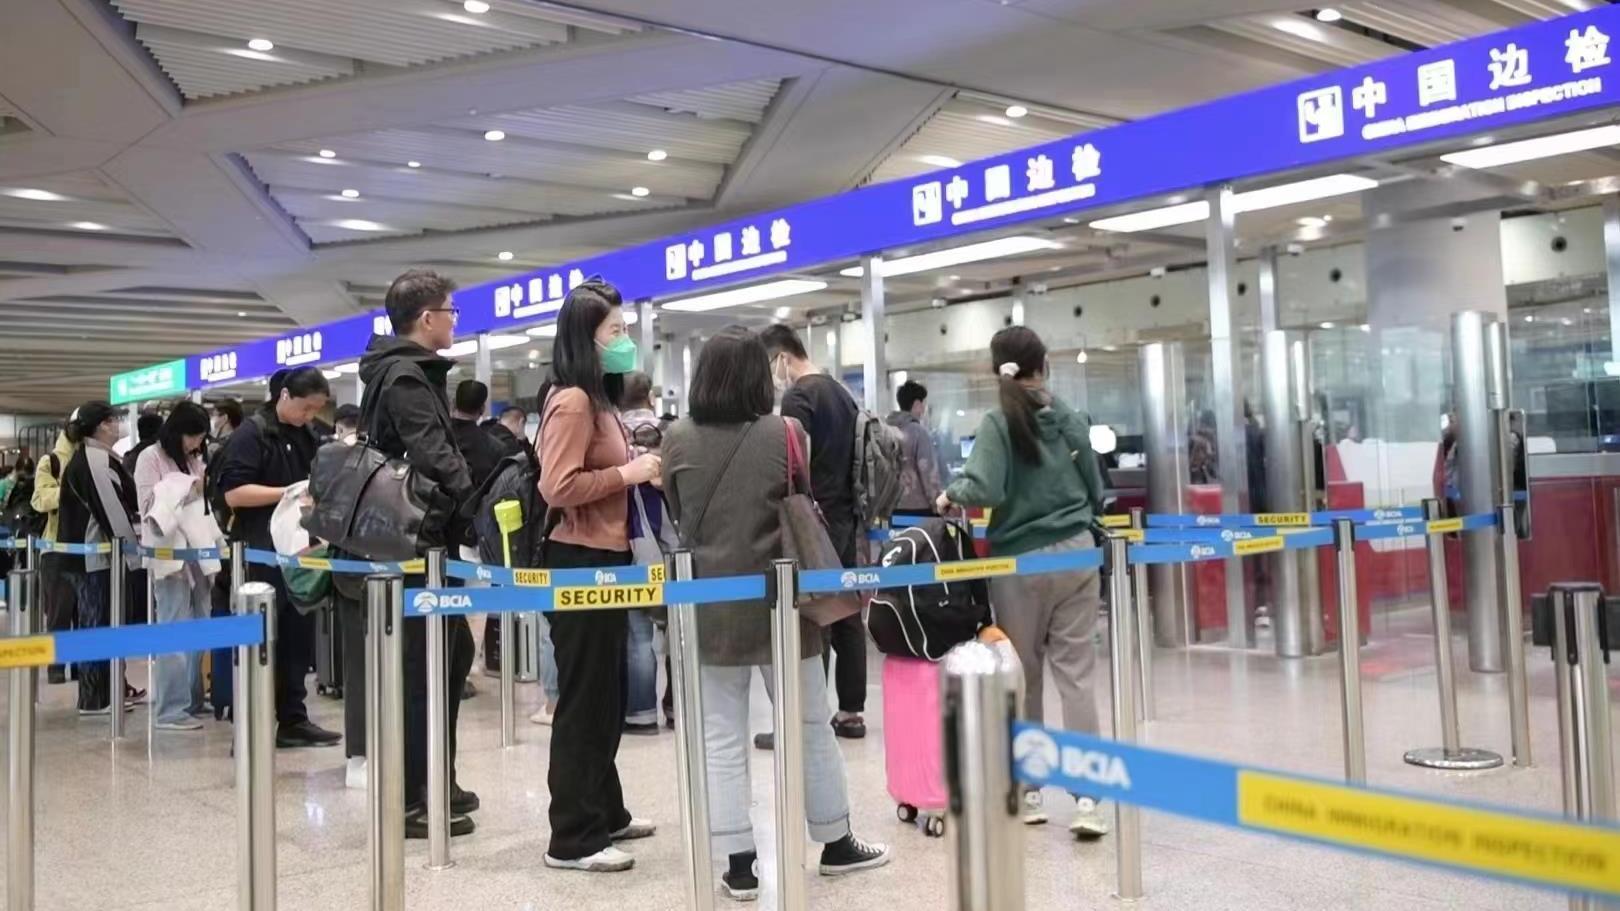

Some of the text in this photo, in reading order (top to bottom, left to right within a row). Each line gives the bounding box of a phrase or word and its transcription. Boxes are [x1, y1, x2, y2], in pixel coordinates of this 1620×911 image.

[515, 571, 548, 584] SECURITY
[440, 594, 472, 608] BCIA
[560, 587, 657, 606] SECURITY
[1061, 745, 1132, 790] BCIA
